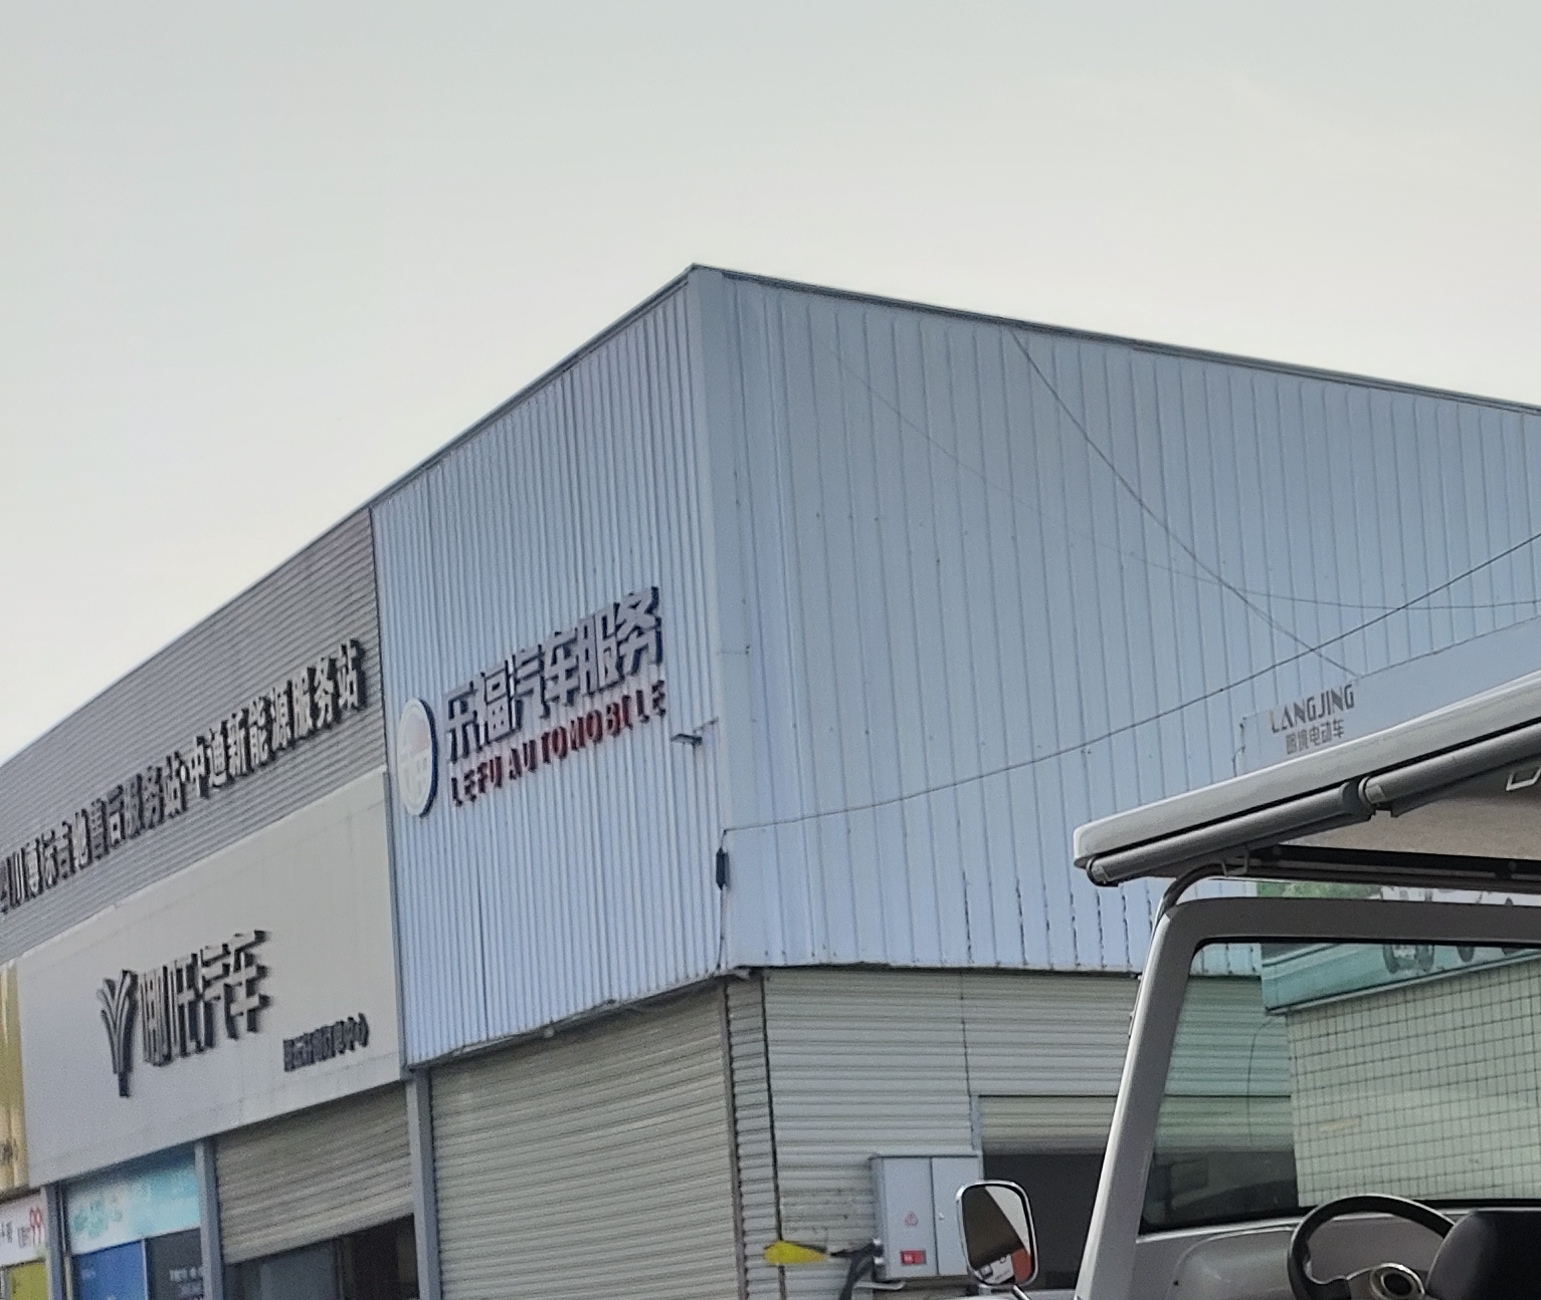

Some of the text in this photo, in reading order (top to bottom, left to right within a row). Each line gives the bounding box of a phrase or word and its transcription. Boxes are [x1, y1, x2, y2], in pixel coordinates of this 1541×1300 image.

[450, 679, 667, 808] LEFU AUTOMOBILE
[1268, 683, 1355, 734] LANGJING
